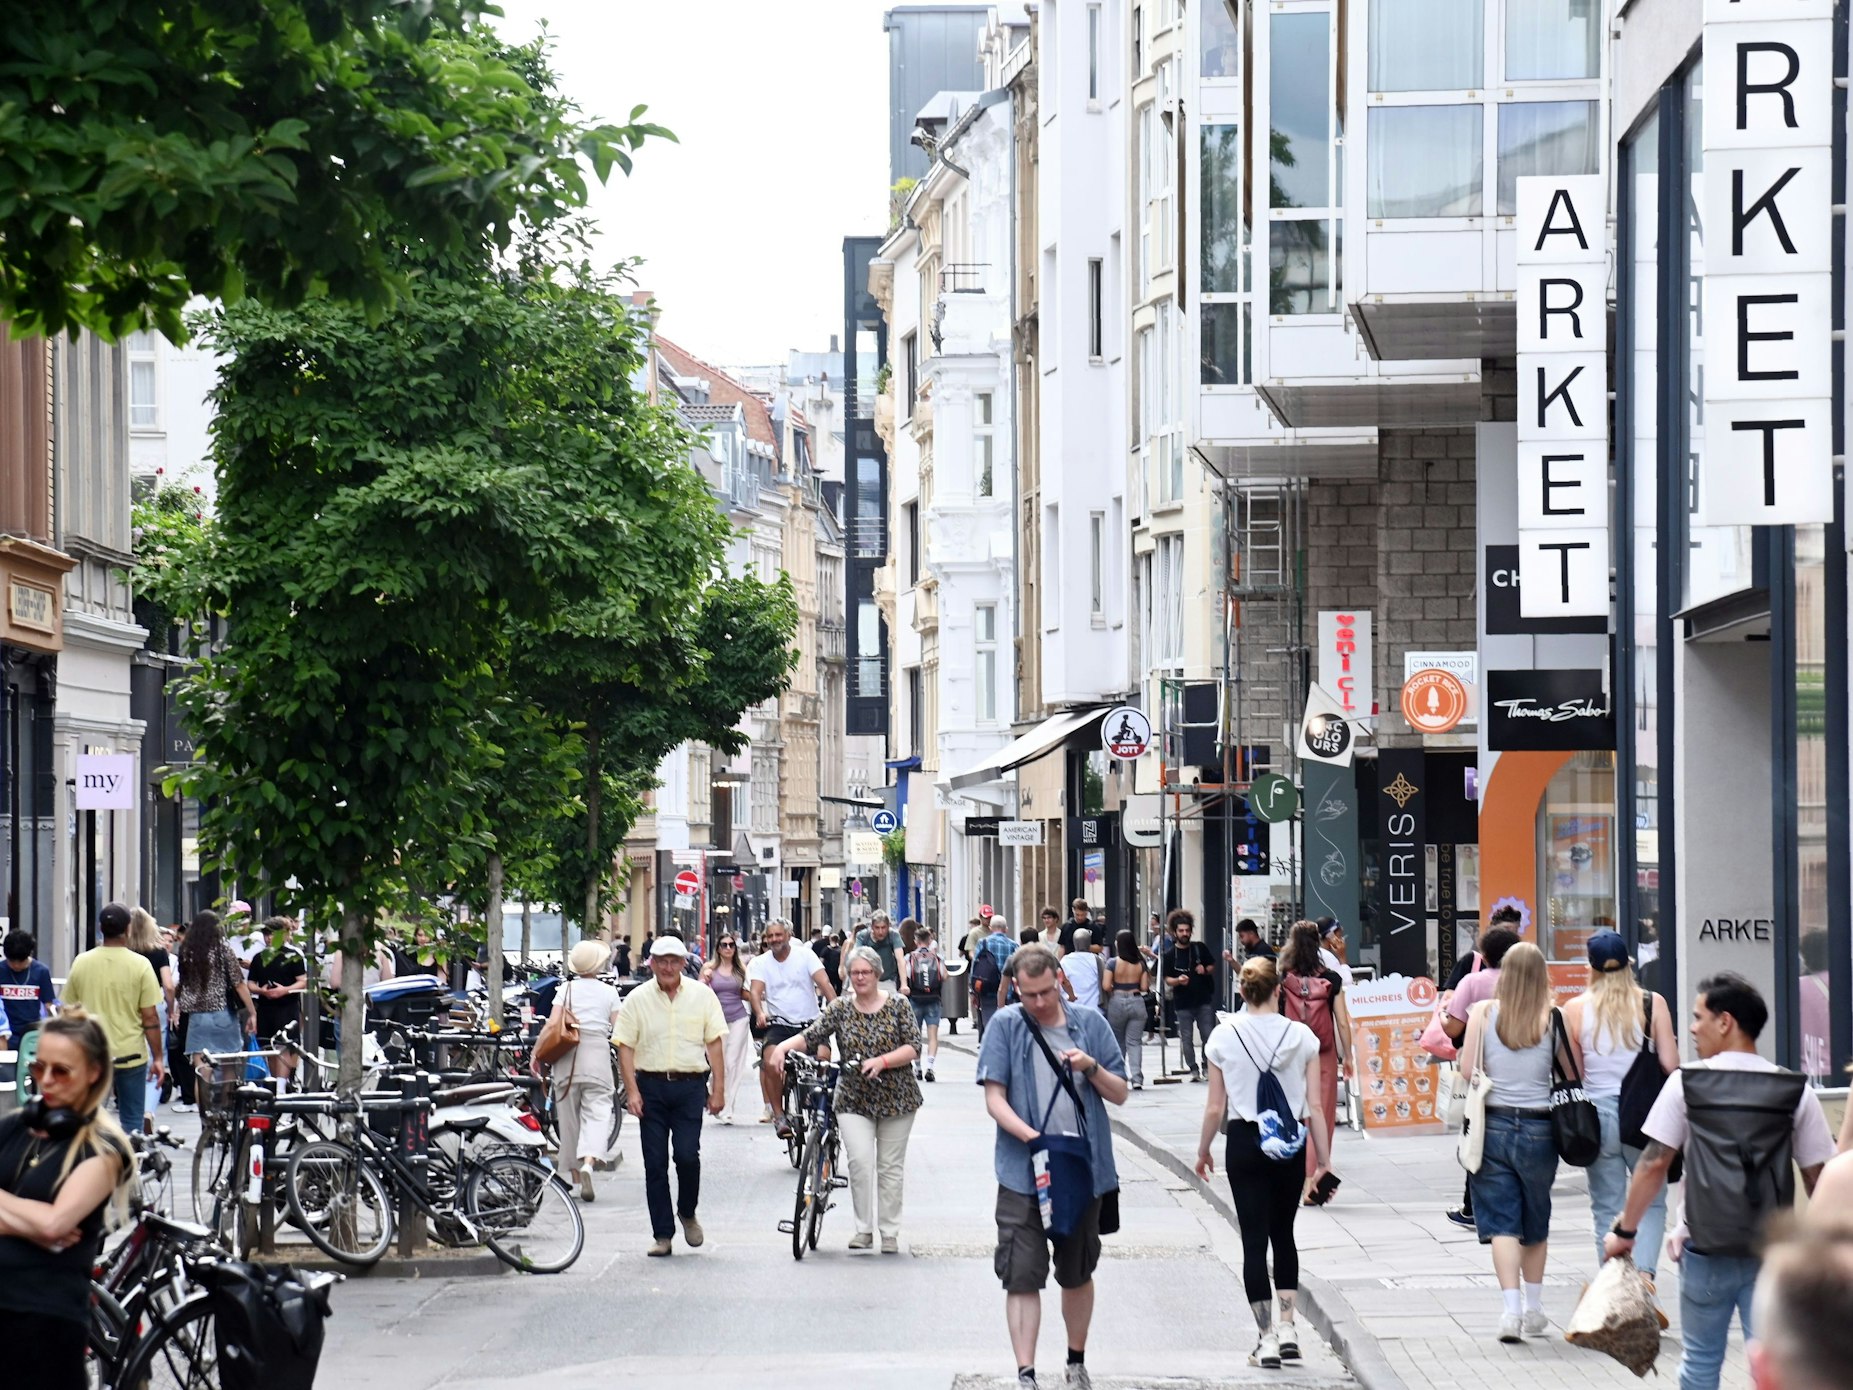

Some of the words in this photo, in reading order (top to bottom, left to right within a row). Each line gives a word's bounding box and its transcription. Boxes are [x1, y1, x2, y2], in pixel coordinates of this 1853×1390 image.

[1730, 0, 1806, 507] RKET
[1534, 189, 1590, 604] ARKET
[1407, 674, 1441, 695] ROCKET
[1494, 698, 1553, 720] Thomas
[1550, 698, 1611, 722] Sabo
[1116, 745, 1139, 755] JOTT
[1313, 738, 1339, 753] URS
[1440, 843, 1451, 863] be
[1388, 813, 1416, 935] VERIS
[1440, 868, 1452, 899] true
[1441, 904, 1452, 919] to
[1699, 919, 1774, 941] ARKE
[3, 988, 36, 997] PARIS
[1352, 993, 1403, 1005] MILCHREIS
